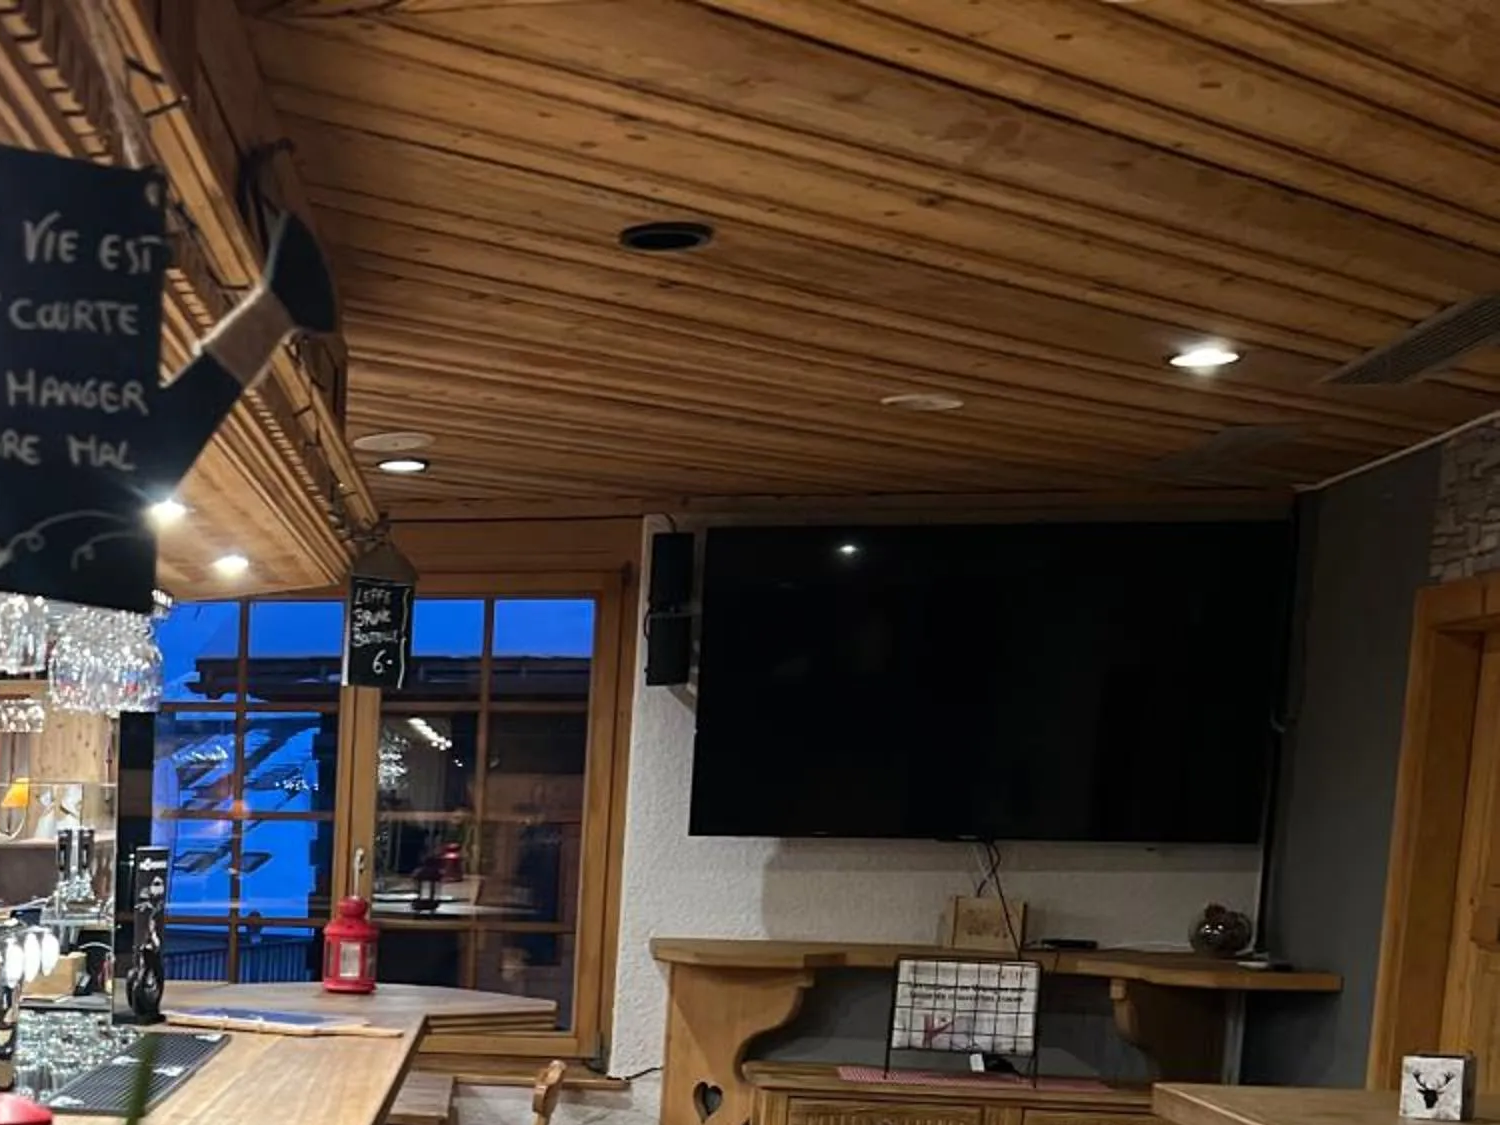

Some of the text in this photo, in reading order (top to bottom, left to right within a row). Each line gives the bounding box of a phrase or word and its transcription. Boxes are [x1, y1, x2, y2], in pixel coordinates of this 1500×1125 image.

[99, 237, 162, 273] EST
[9, 295, 141, 337] COURTE
[6, 370, 151, 416] MANGER
